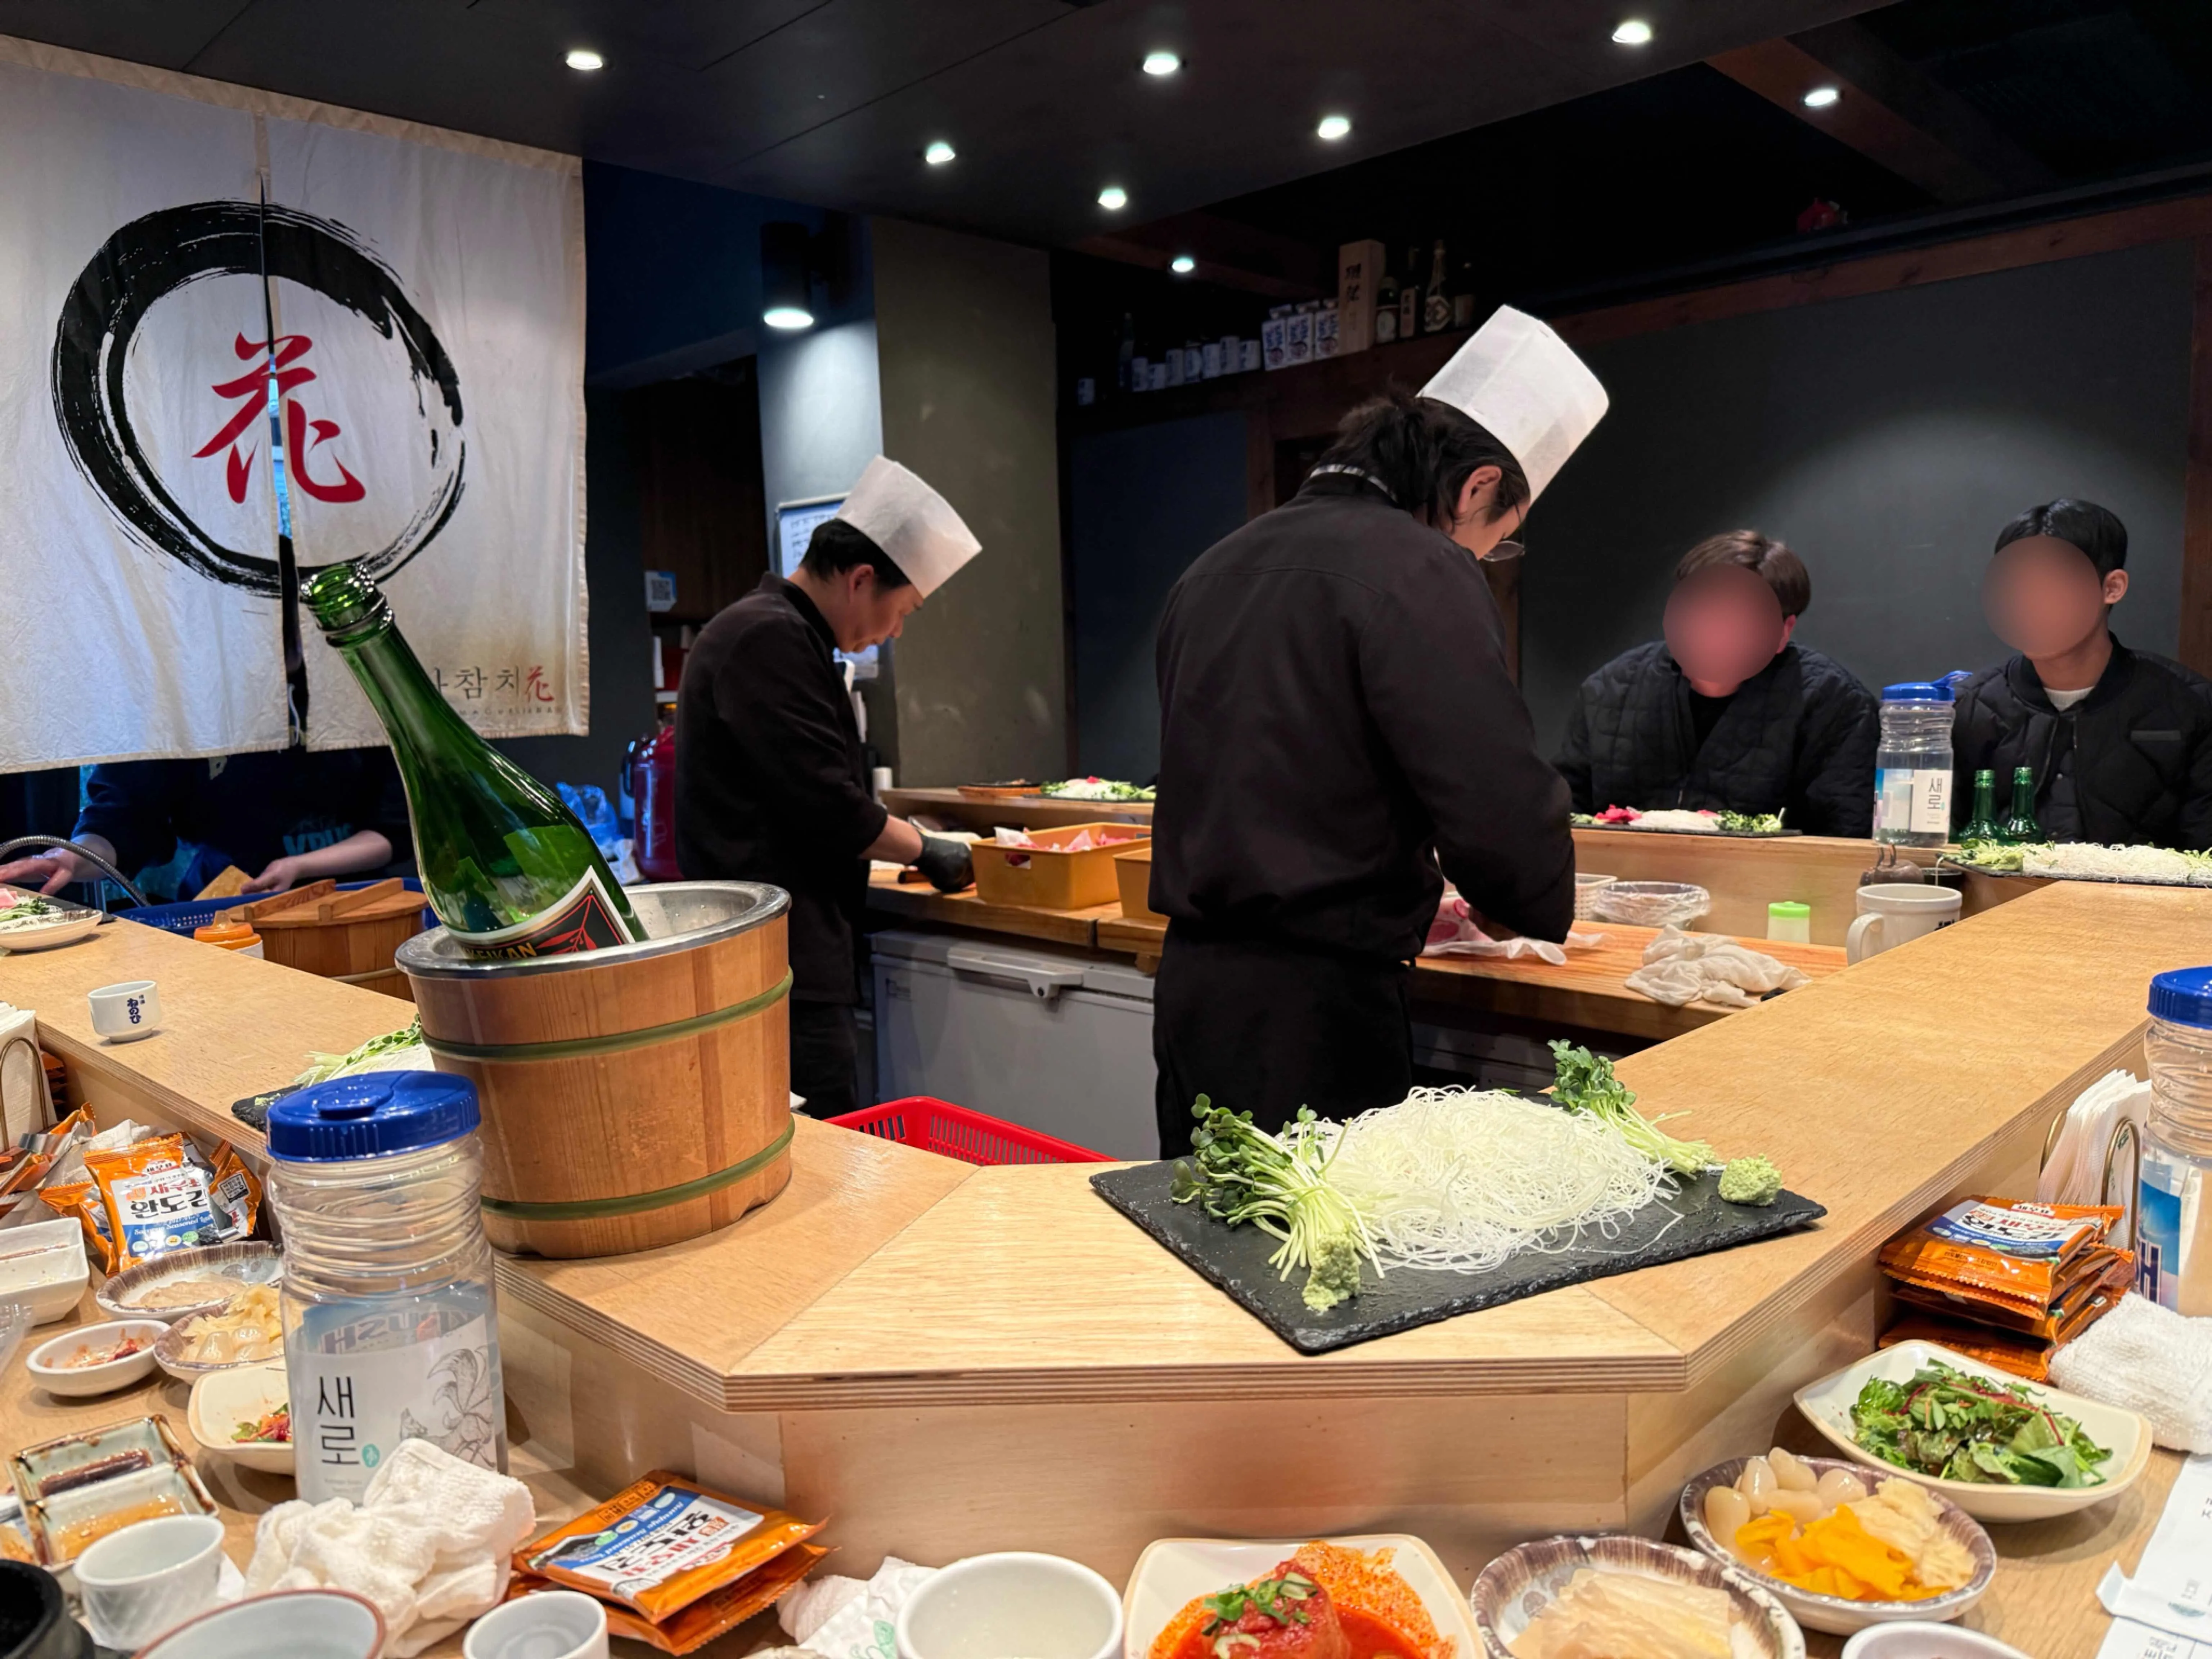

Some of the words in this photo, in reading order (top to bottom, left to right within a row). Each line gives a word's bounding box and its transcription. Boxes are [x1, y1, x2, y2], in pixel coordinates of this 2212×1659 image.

[192, 332, 366, 503] 花
[1926, 777, 1943, 809] 새로
[318, 1376, 359, 1465] 새로
